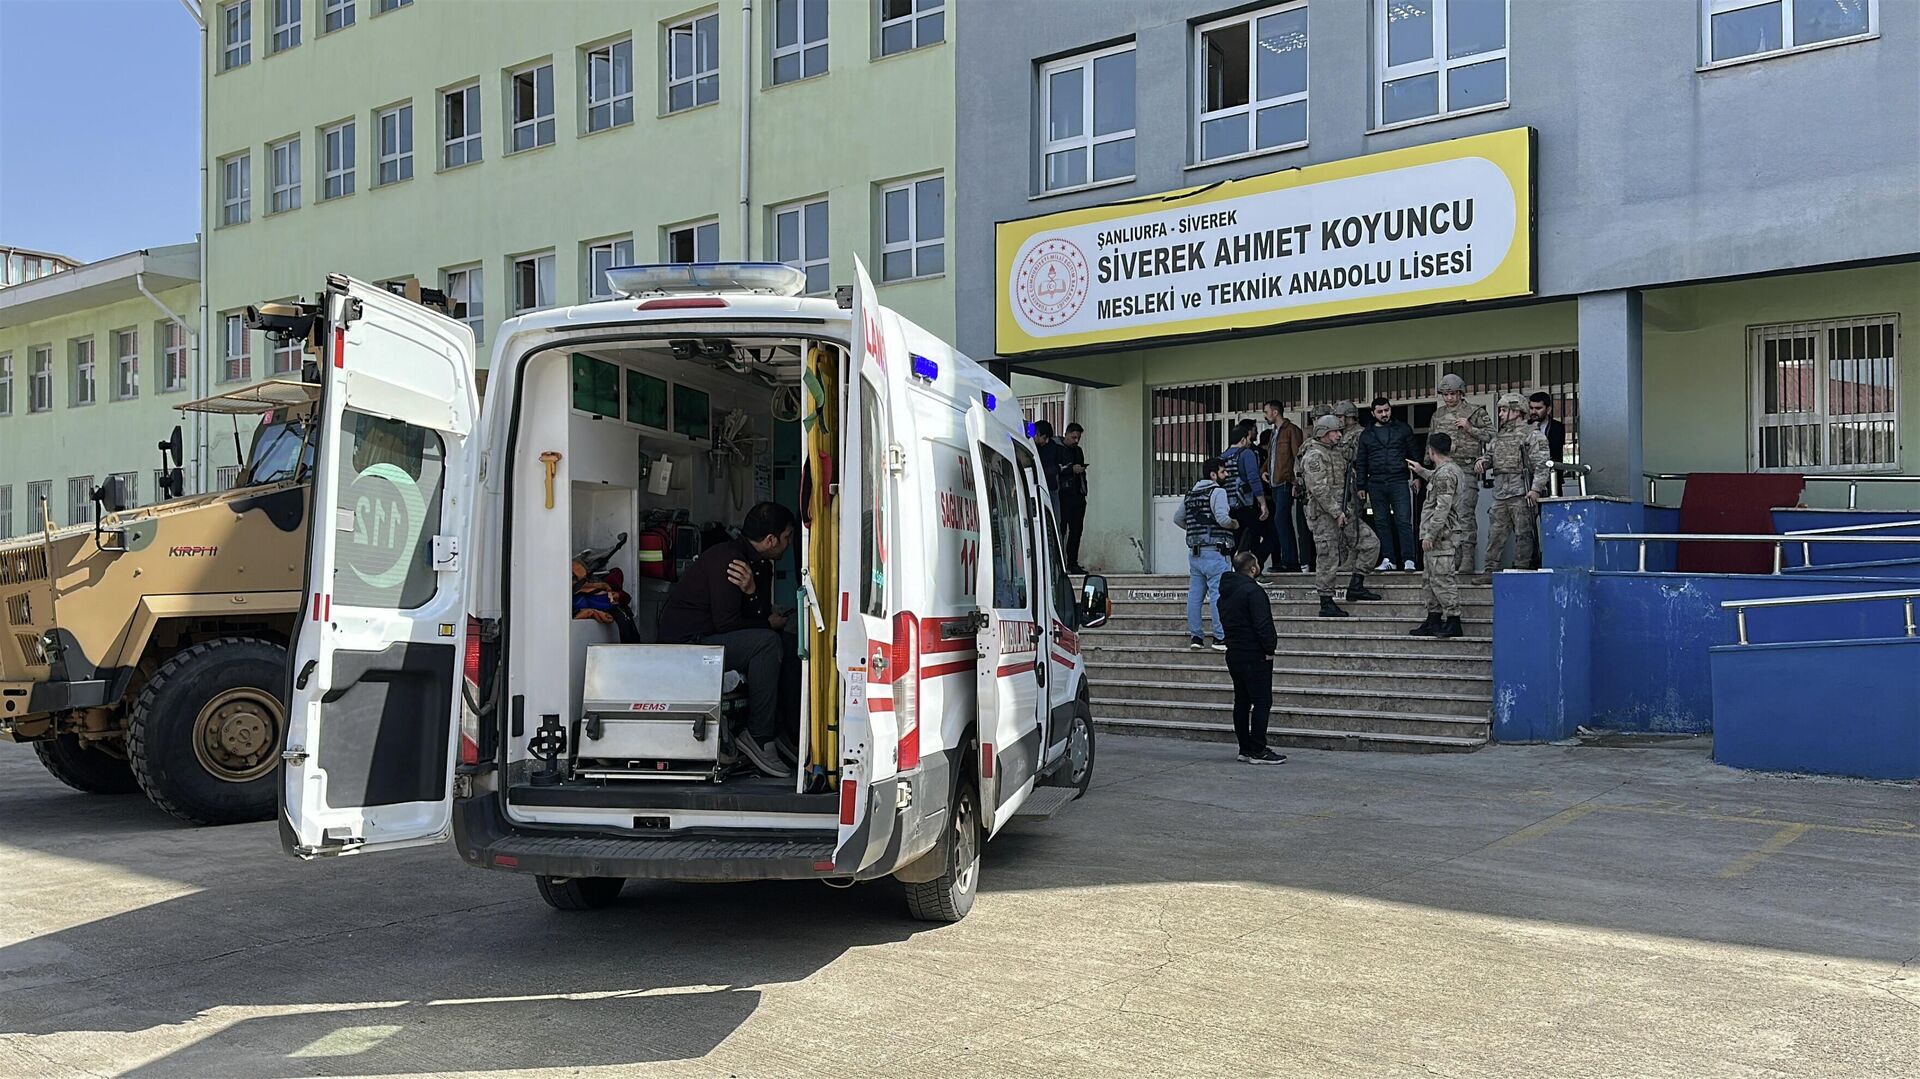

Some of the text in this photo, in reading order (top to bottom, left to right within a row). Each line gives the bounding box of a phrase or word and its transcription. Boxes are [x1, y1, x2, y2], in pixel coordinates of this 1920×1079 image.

[1097, 224, 1168, 250] ŞANLIURFA
[1179, 209, 1238, 233] SİVEREK
[1097, 198, 1474, 284] SİVEREK AHMET KOYUNCU
[1097, 243, 1473, 320] MESLEKİ ve TEKNİK ANADOLU LİSESİ
[940, 486, 965, 531] SAĞLIK
[960, 538, 980, 596] 11
[642, 703, 667, 711] EMS
